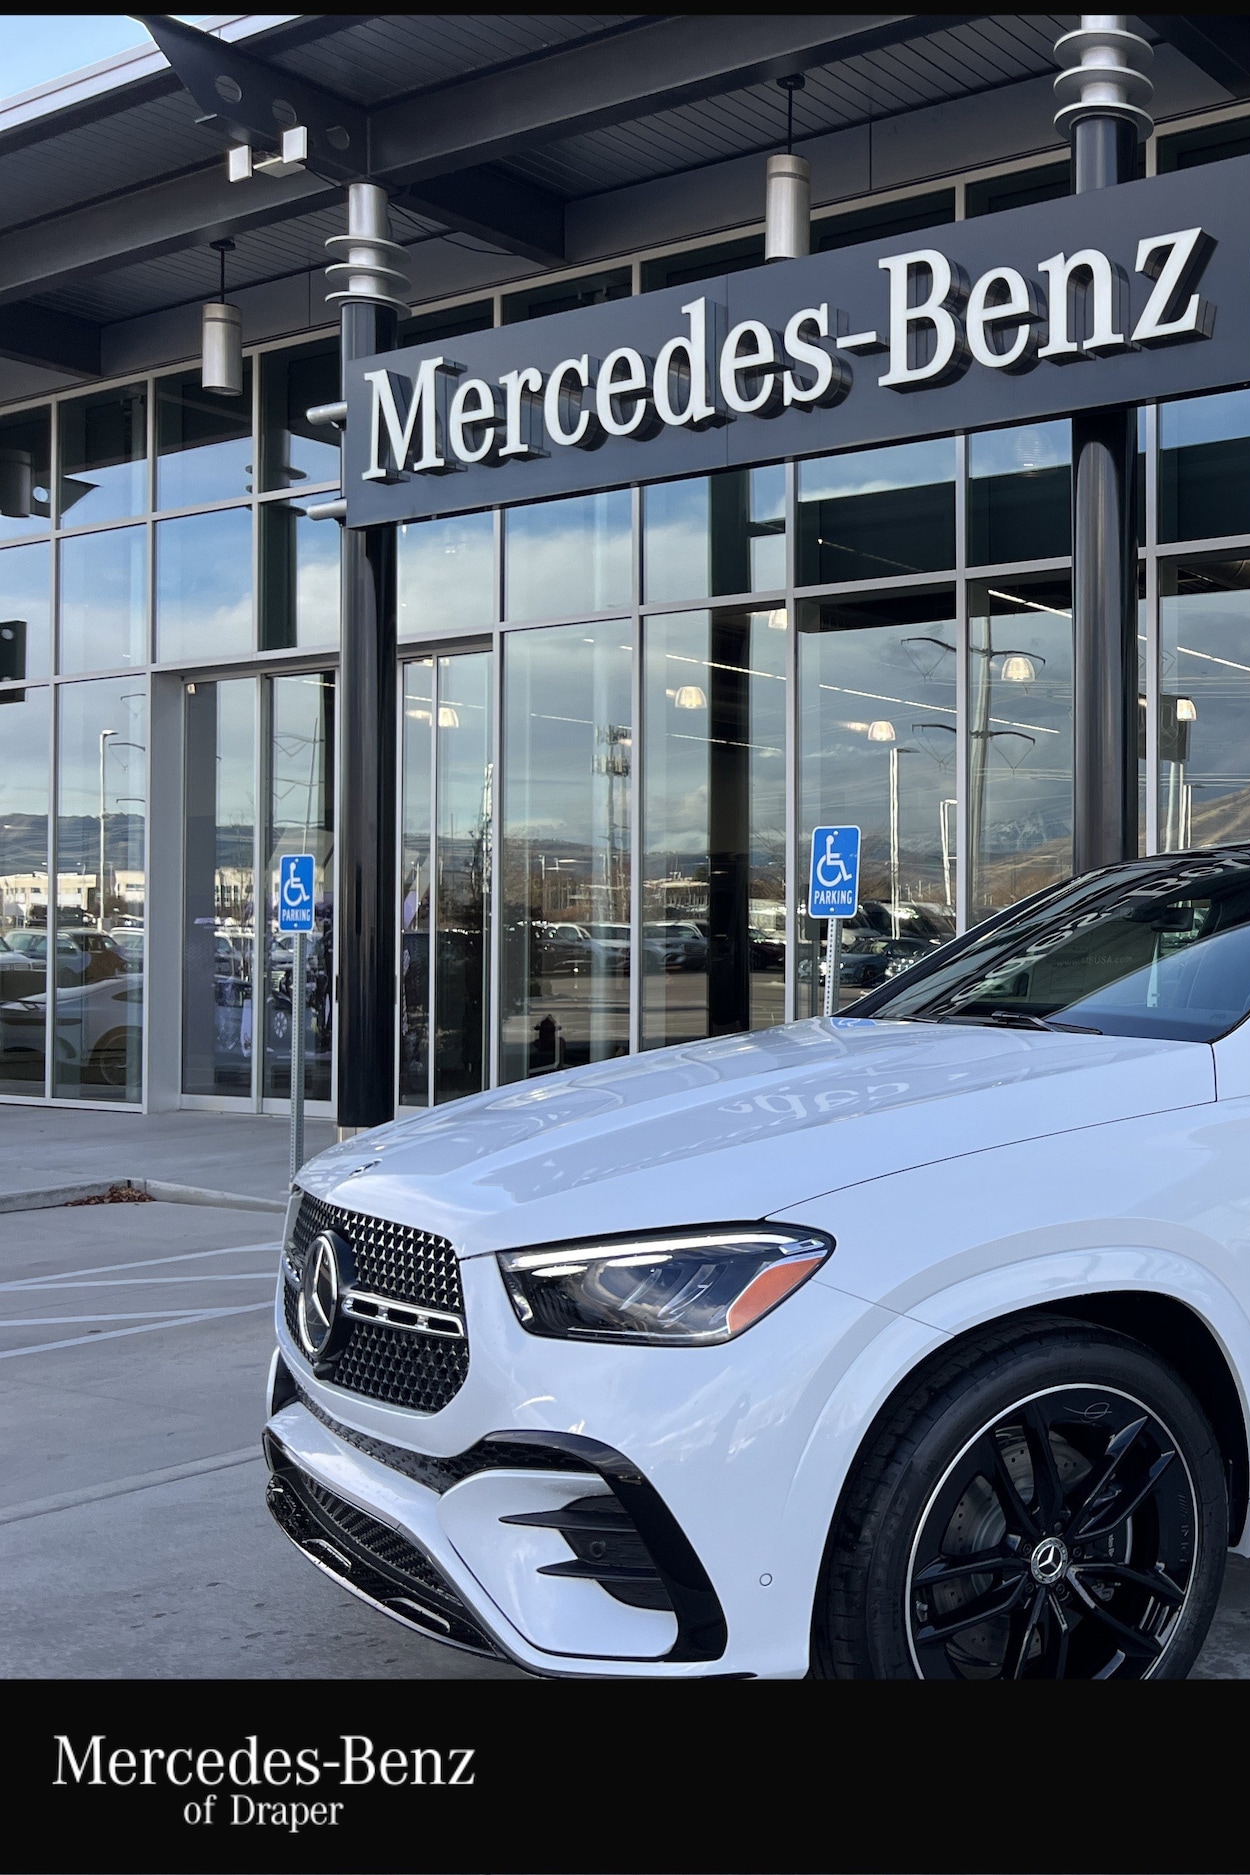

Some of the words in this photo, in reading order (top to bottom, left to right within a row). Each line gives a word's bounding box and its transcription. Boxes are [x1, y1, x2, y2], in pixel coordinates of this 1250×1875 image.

[361, 227, 1204, 482] Mercedes-Benz
[813, 889, 853, 905] PARKING
[281, 908, 311, 922] PARKING
